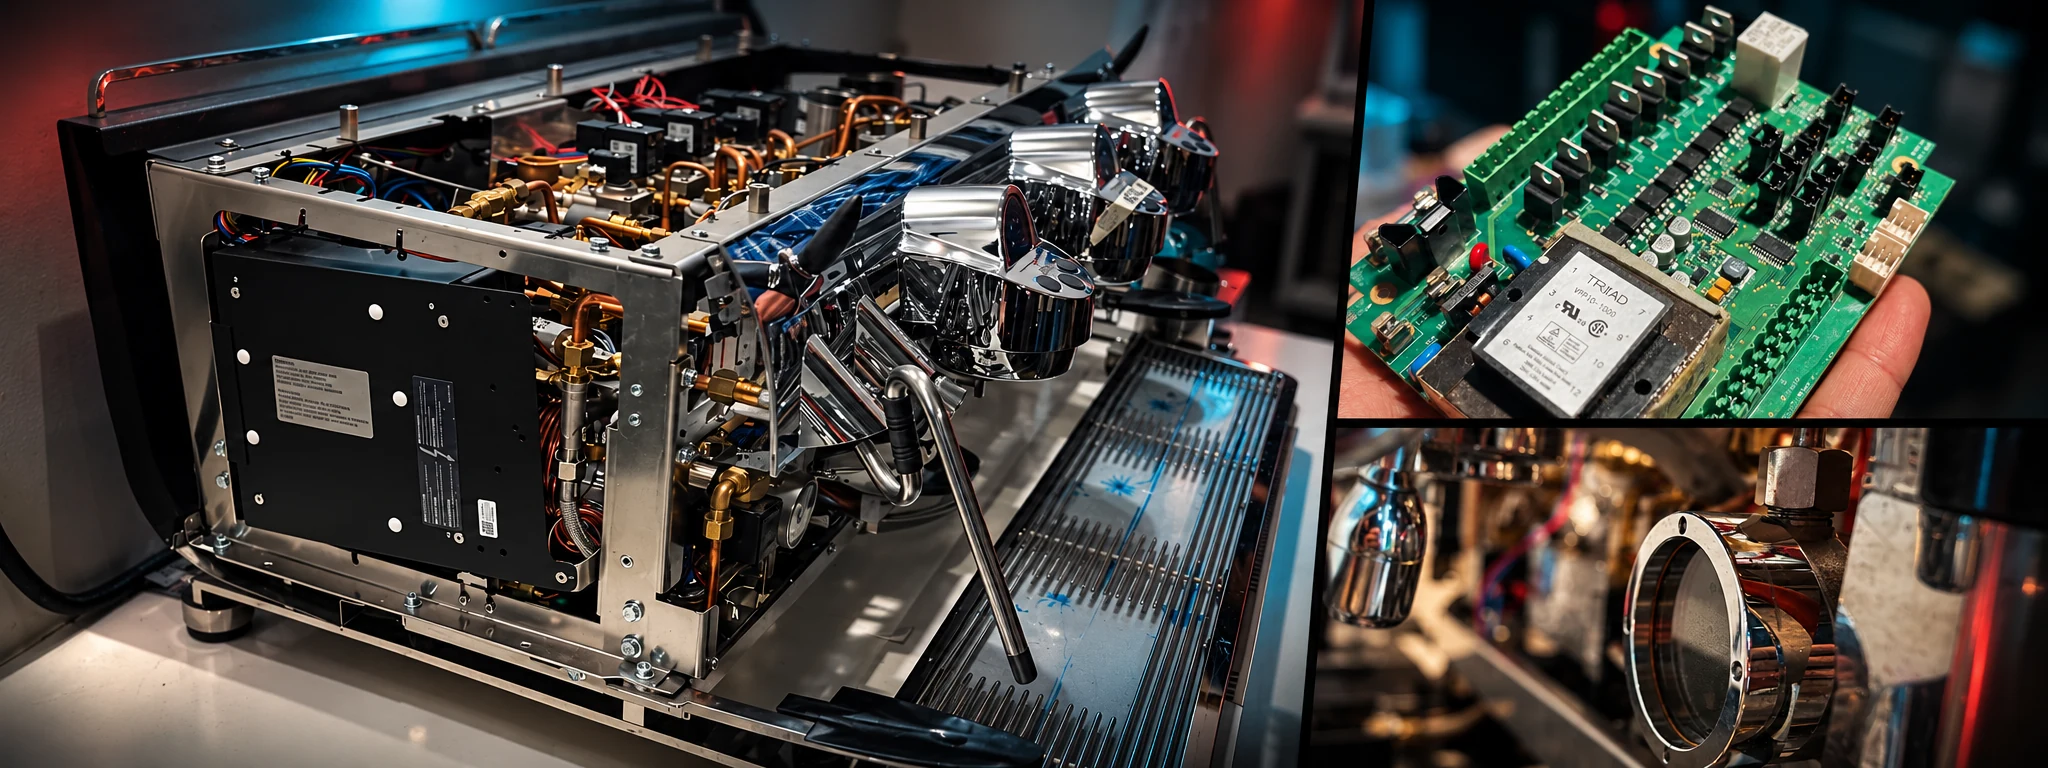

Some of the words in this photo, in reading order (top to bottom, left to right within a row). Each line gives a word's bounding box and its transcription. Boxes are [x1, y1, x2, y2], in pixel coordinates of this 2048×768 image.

[1548, 289, 1557, 297] 3
[1502, 338, 1511, 346] 6
[1592, 358, 1605, 369] 10
[1569, 386, 1582, 397] 12
